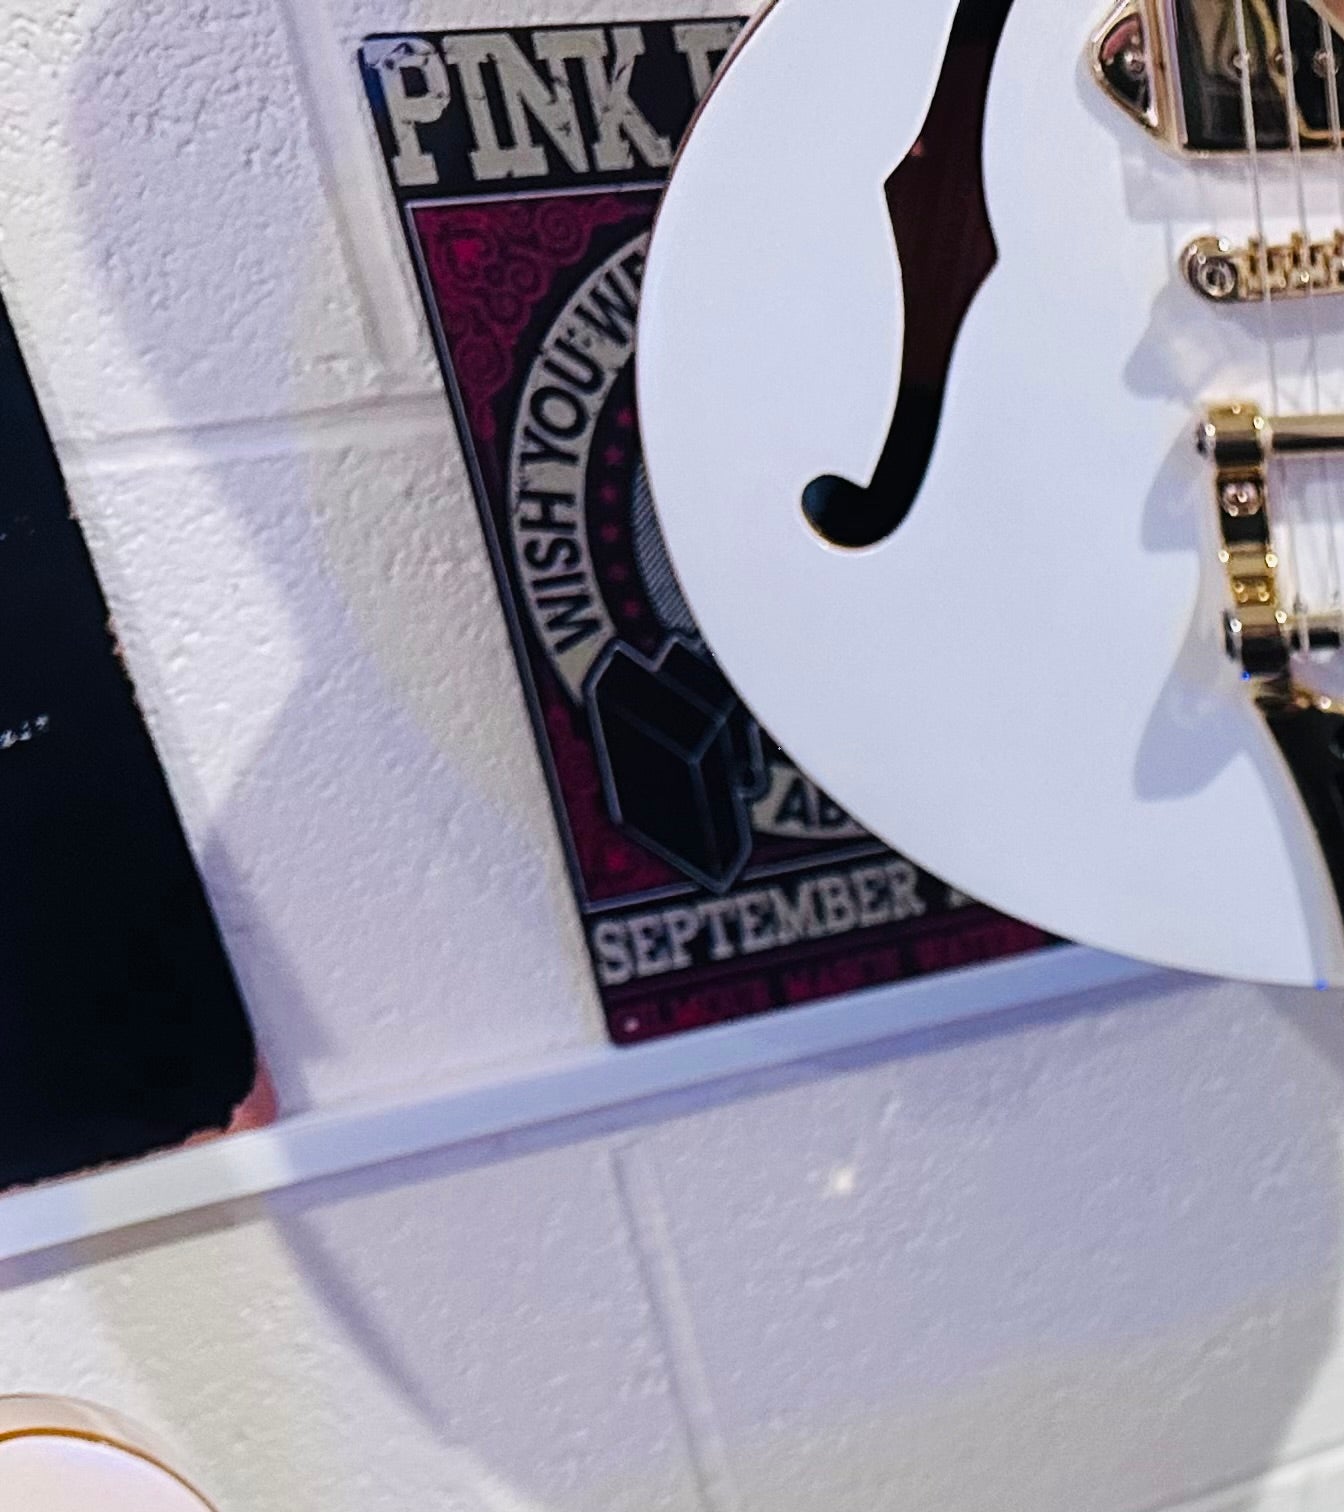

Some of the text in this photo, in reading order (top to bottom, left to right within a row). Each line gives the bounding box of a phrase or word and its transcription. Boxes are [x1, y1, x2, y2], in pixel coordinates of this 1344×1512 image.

[363, 26, 675, 187] PINK
[519, 337, 605, 466] YOU
[517, 488, 602, 654] WISH
[593, 859, 927, 986] SEPTEMBER
